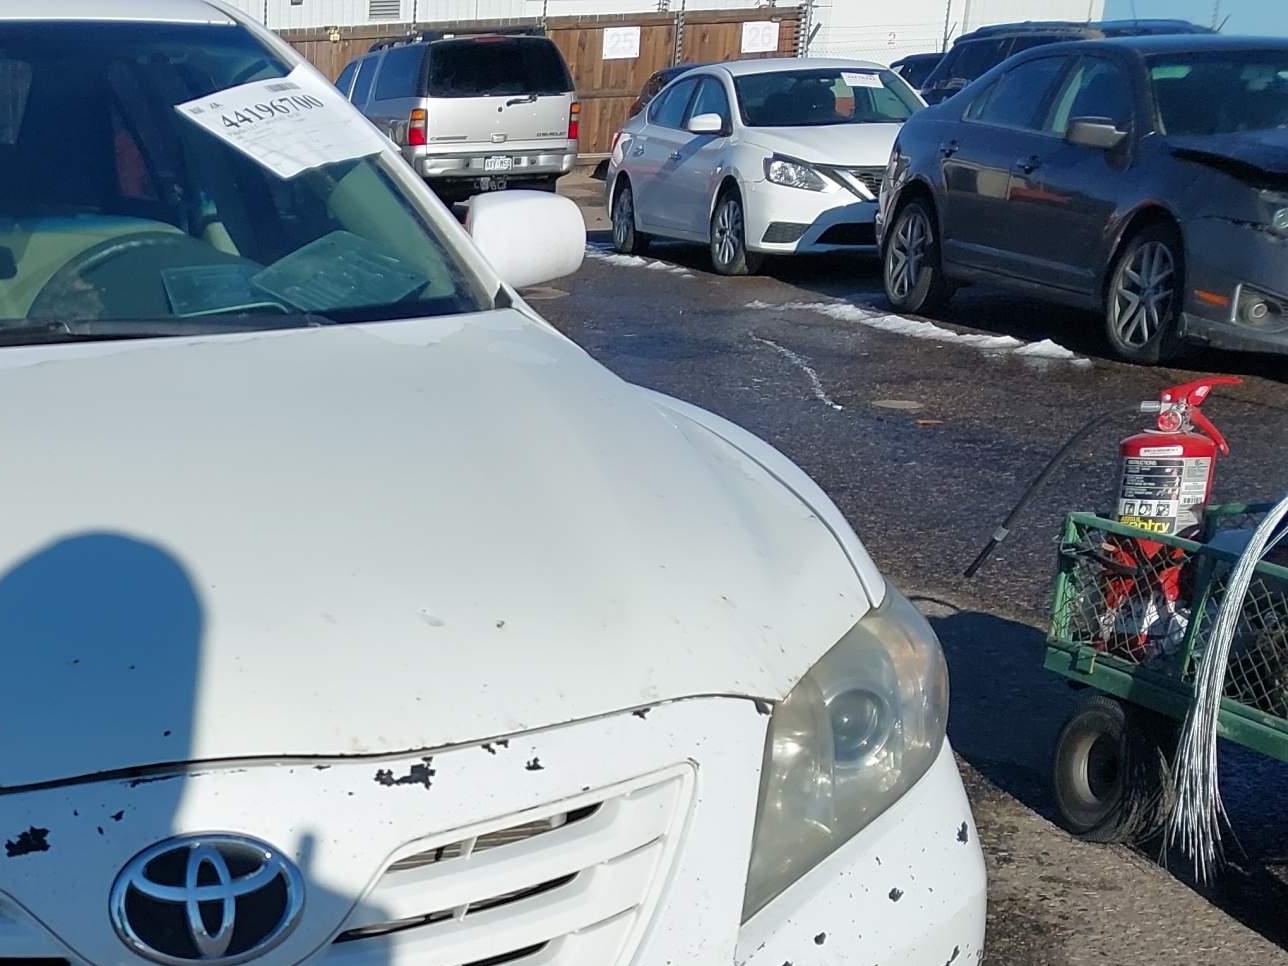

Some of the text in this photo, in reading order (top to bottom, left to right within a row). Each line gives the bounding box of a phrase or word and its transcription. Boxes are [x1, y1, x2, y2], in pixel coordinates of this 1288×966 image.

[609, 32, 634, 52] 25
[748, 25, 772, 47] 26
[221, 95, 324, 128] 44196700
